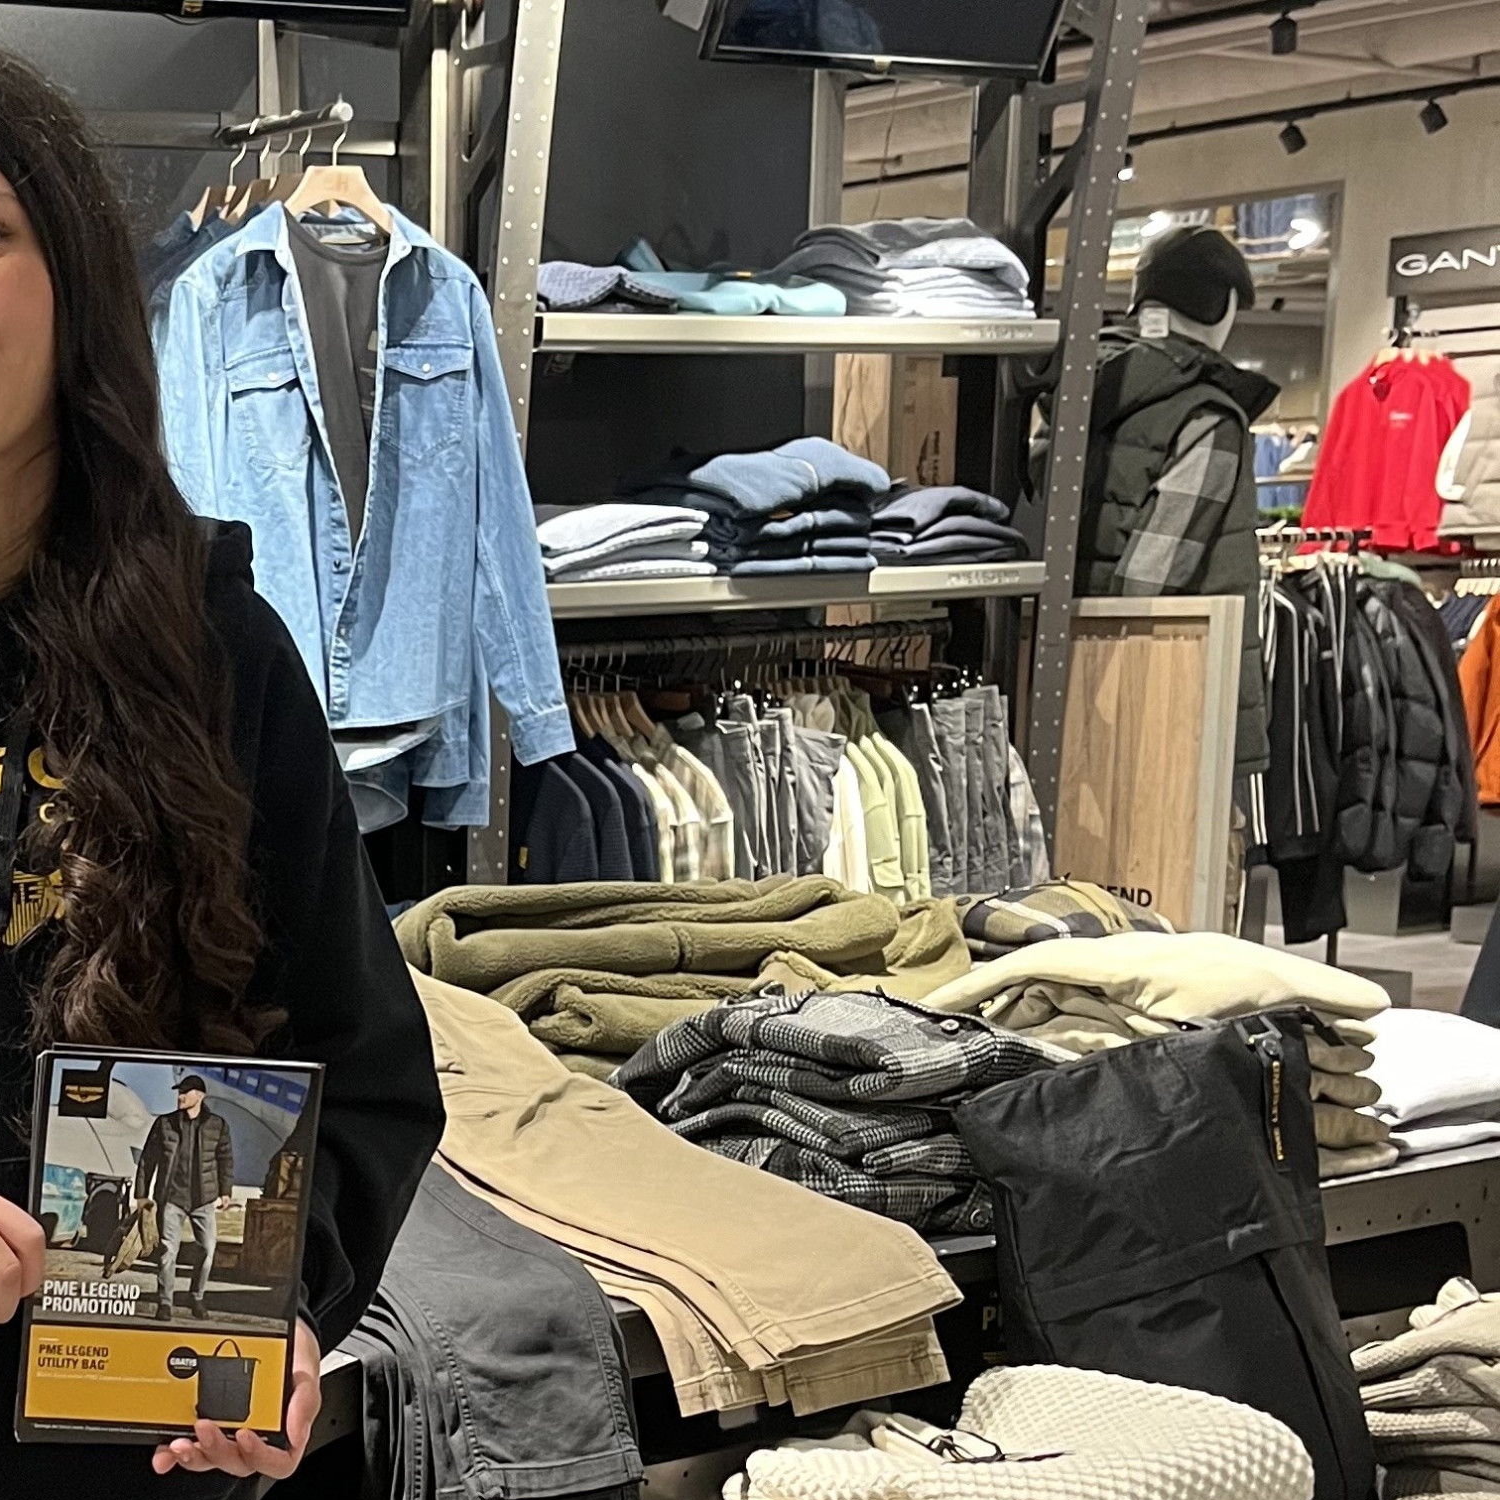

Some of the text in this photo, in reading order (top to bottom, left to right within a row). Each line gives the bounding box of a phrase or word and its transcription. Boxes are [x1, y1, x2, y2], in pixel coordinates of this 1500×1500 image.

[1395, 244, 1500, 277] GAN
[43, 1280, 141, 1300] PME LEGEND
[42, 1296, 136, 1316] PROMOTION
[38, 1343, 109, 1357] PME LEGEND
[37, 1357, 78, 1369] UTILITY
